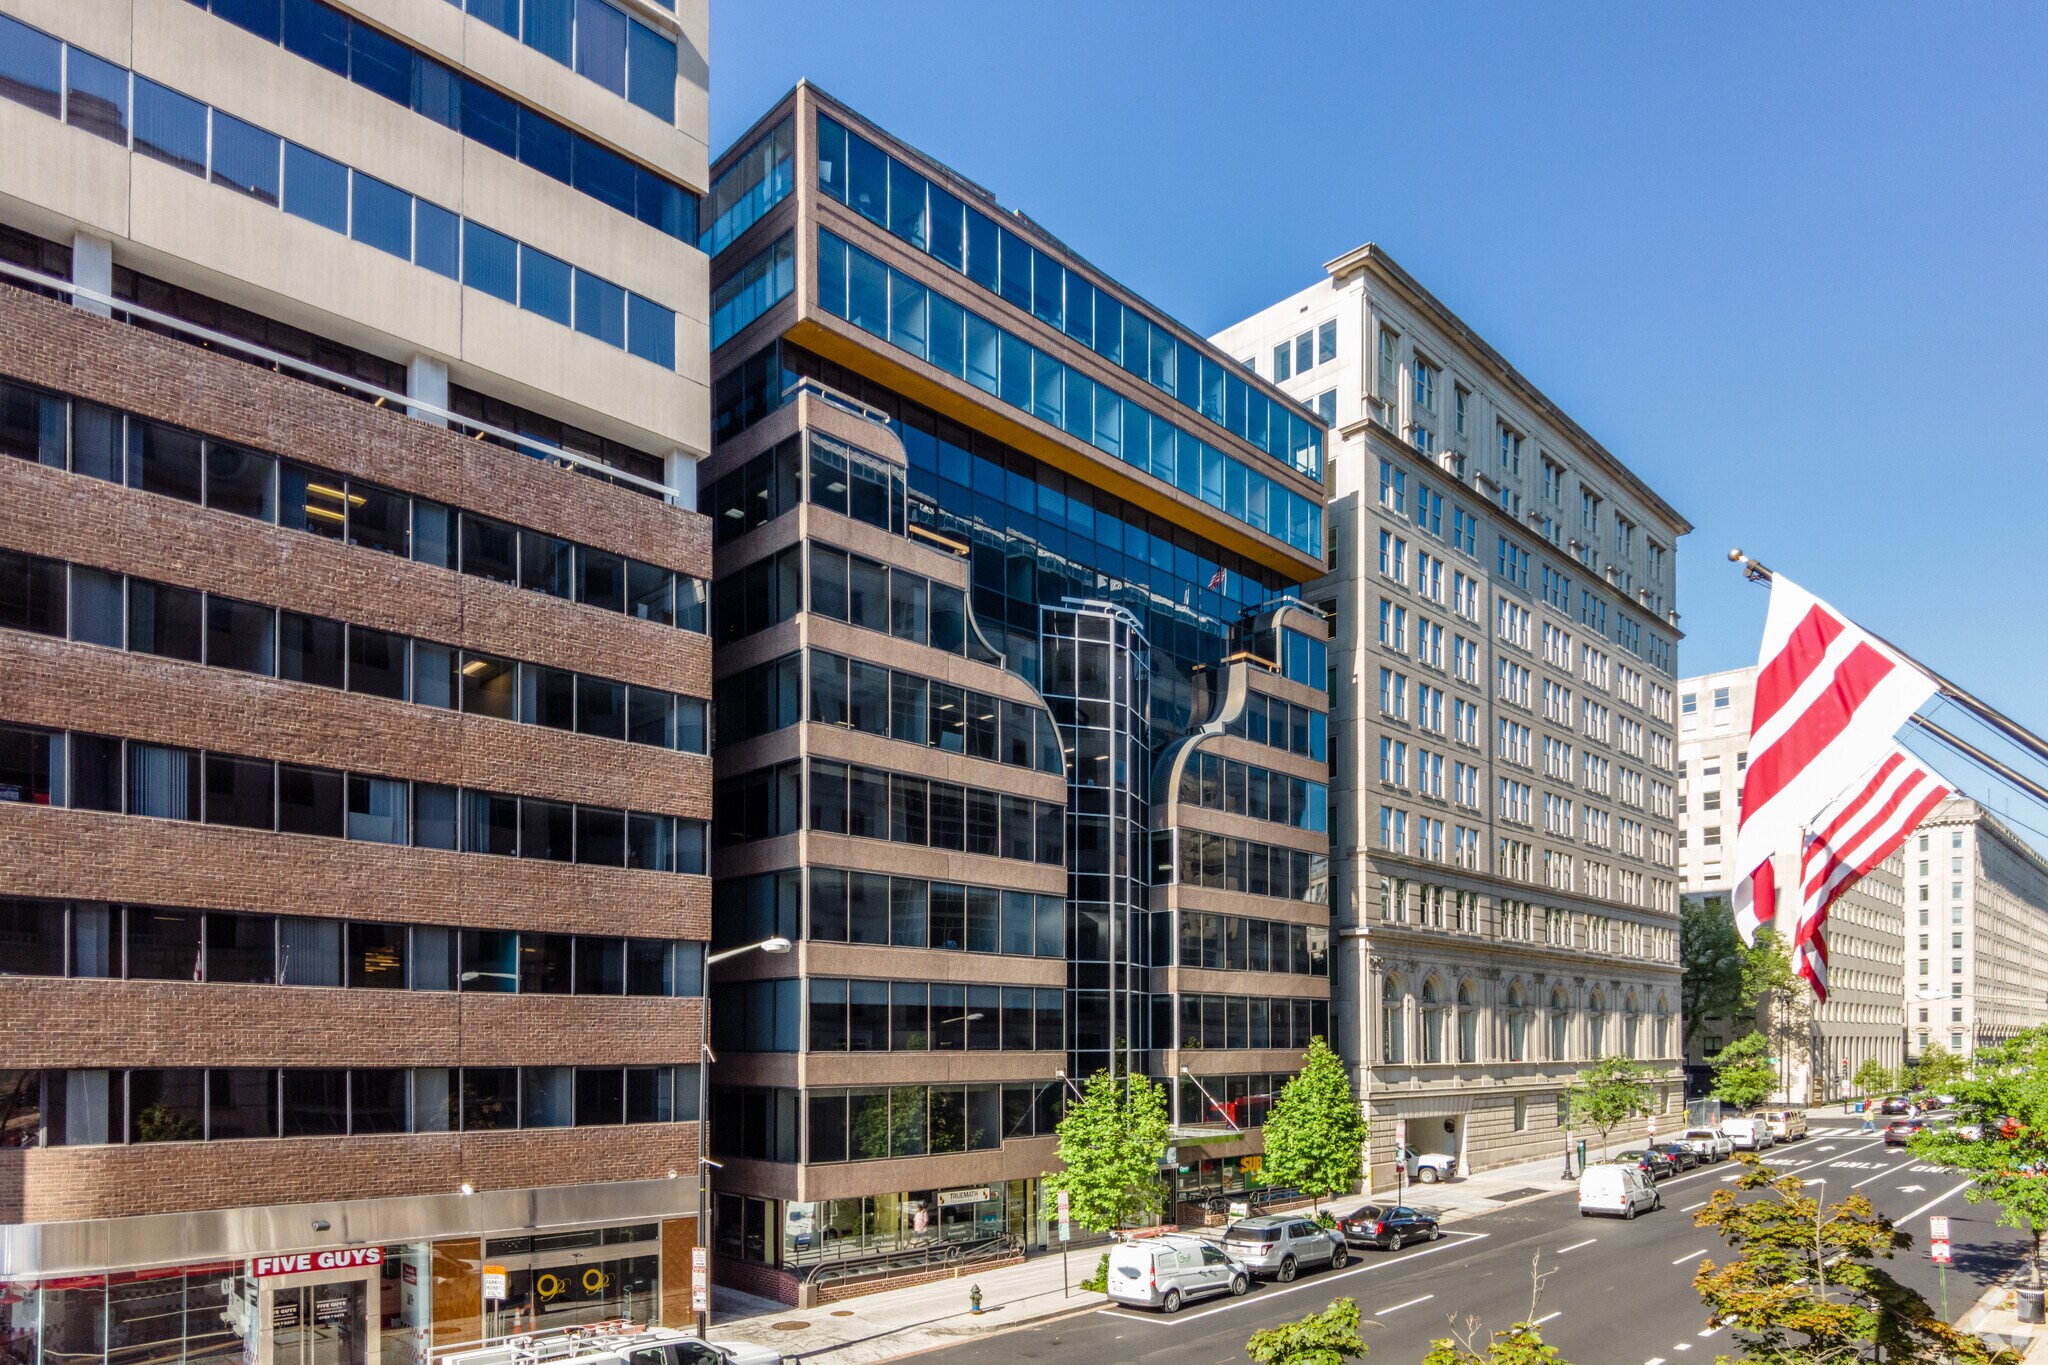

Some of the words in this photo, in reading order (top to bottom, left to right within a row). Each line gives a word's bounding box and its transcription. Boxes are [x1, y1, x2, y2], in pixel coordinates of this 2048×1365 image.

[1829, 1161, 1889, 1169] ONLY
[950, 1191, 979, 1200] TRUEMATH
[258, 1254, 312, 1275] FIVE
[318, 1248, 380, 1268] GUYS
